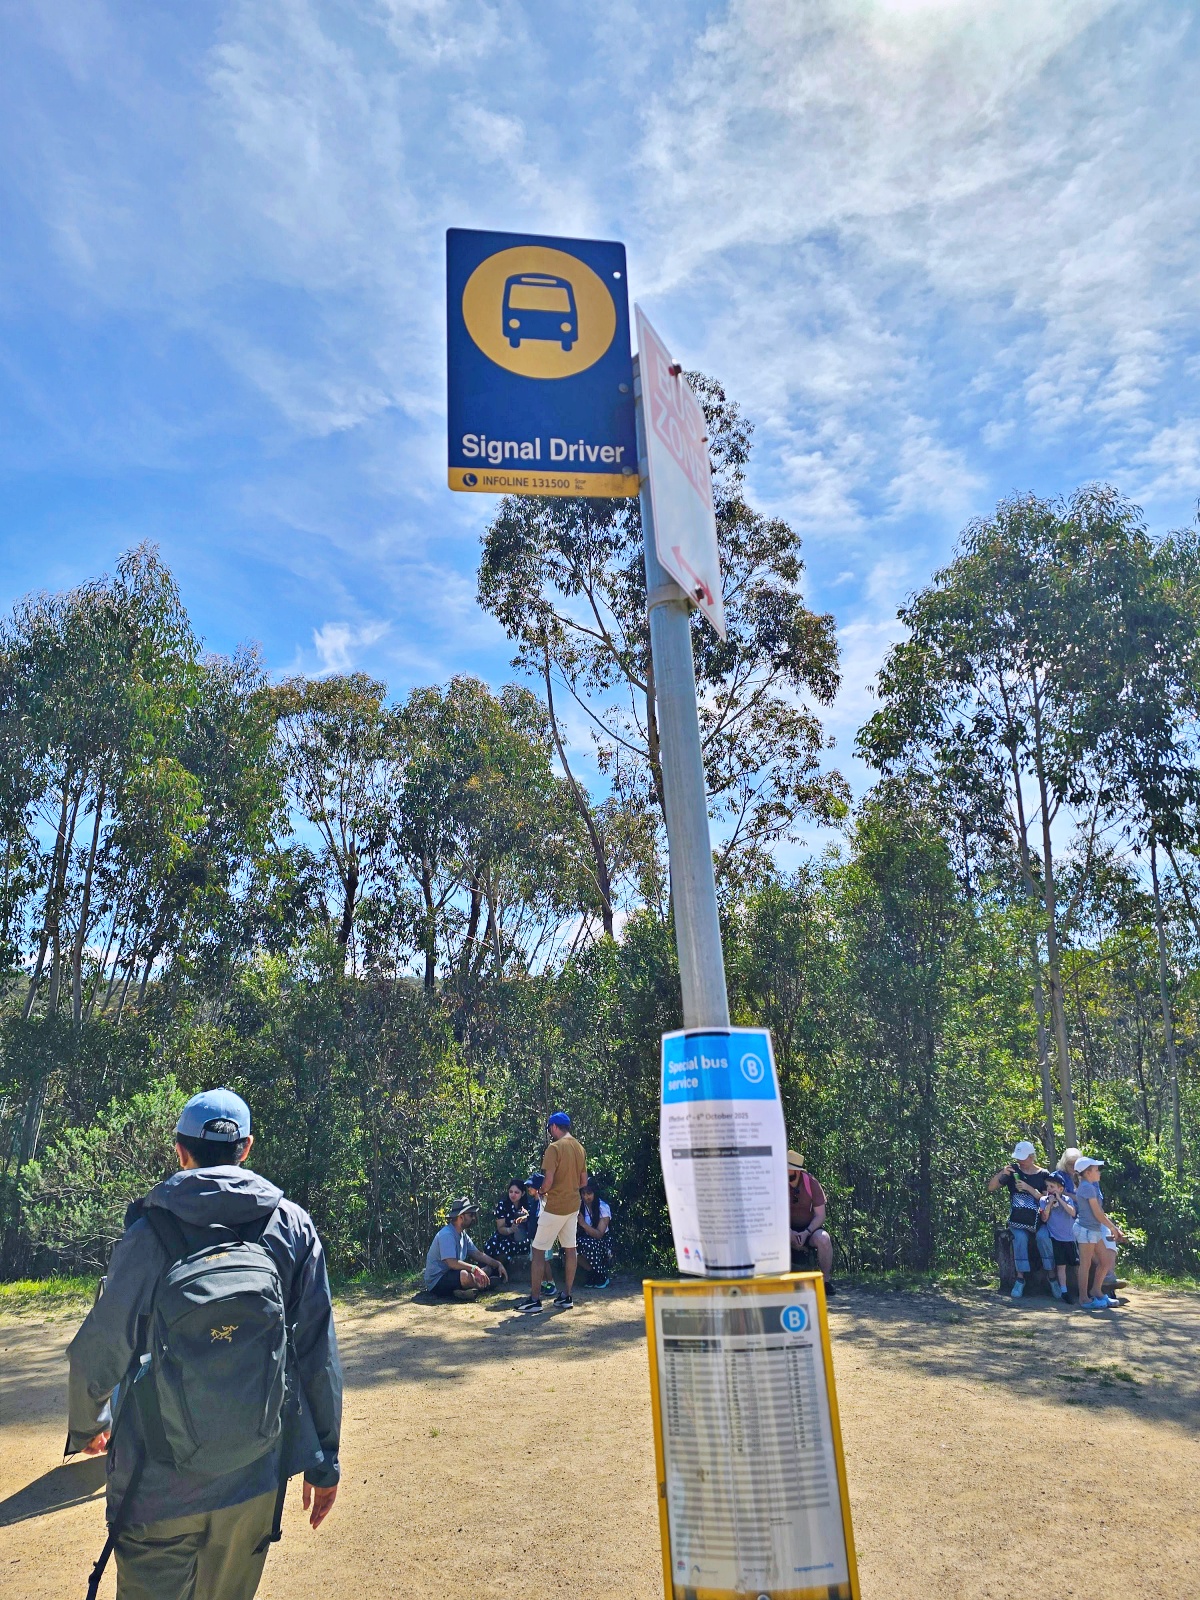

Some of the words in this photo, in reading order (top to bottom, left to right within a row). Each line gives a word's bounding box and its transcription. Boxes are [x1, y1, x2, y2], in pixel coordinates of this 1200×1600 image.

[656, 351, 697, 441] BUS
[462, 433, 541, 464] Signal
[550, 438, 625, 463] Driver
[653, 391, 708, 502] ZONE
[482, 475, 529, 487] INFOLINE
[532, 478, 570, 489] 131500
[668, 1055, 699, 1075] Special
[701, 1054, 728, 1070] bus
[746, 1059, 759, 1077] B
[668, 1076, 699, 1091] service
[705, 1112, 733, 1120] October
[788, 1310, 801, 1329] B
